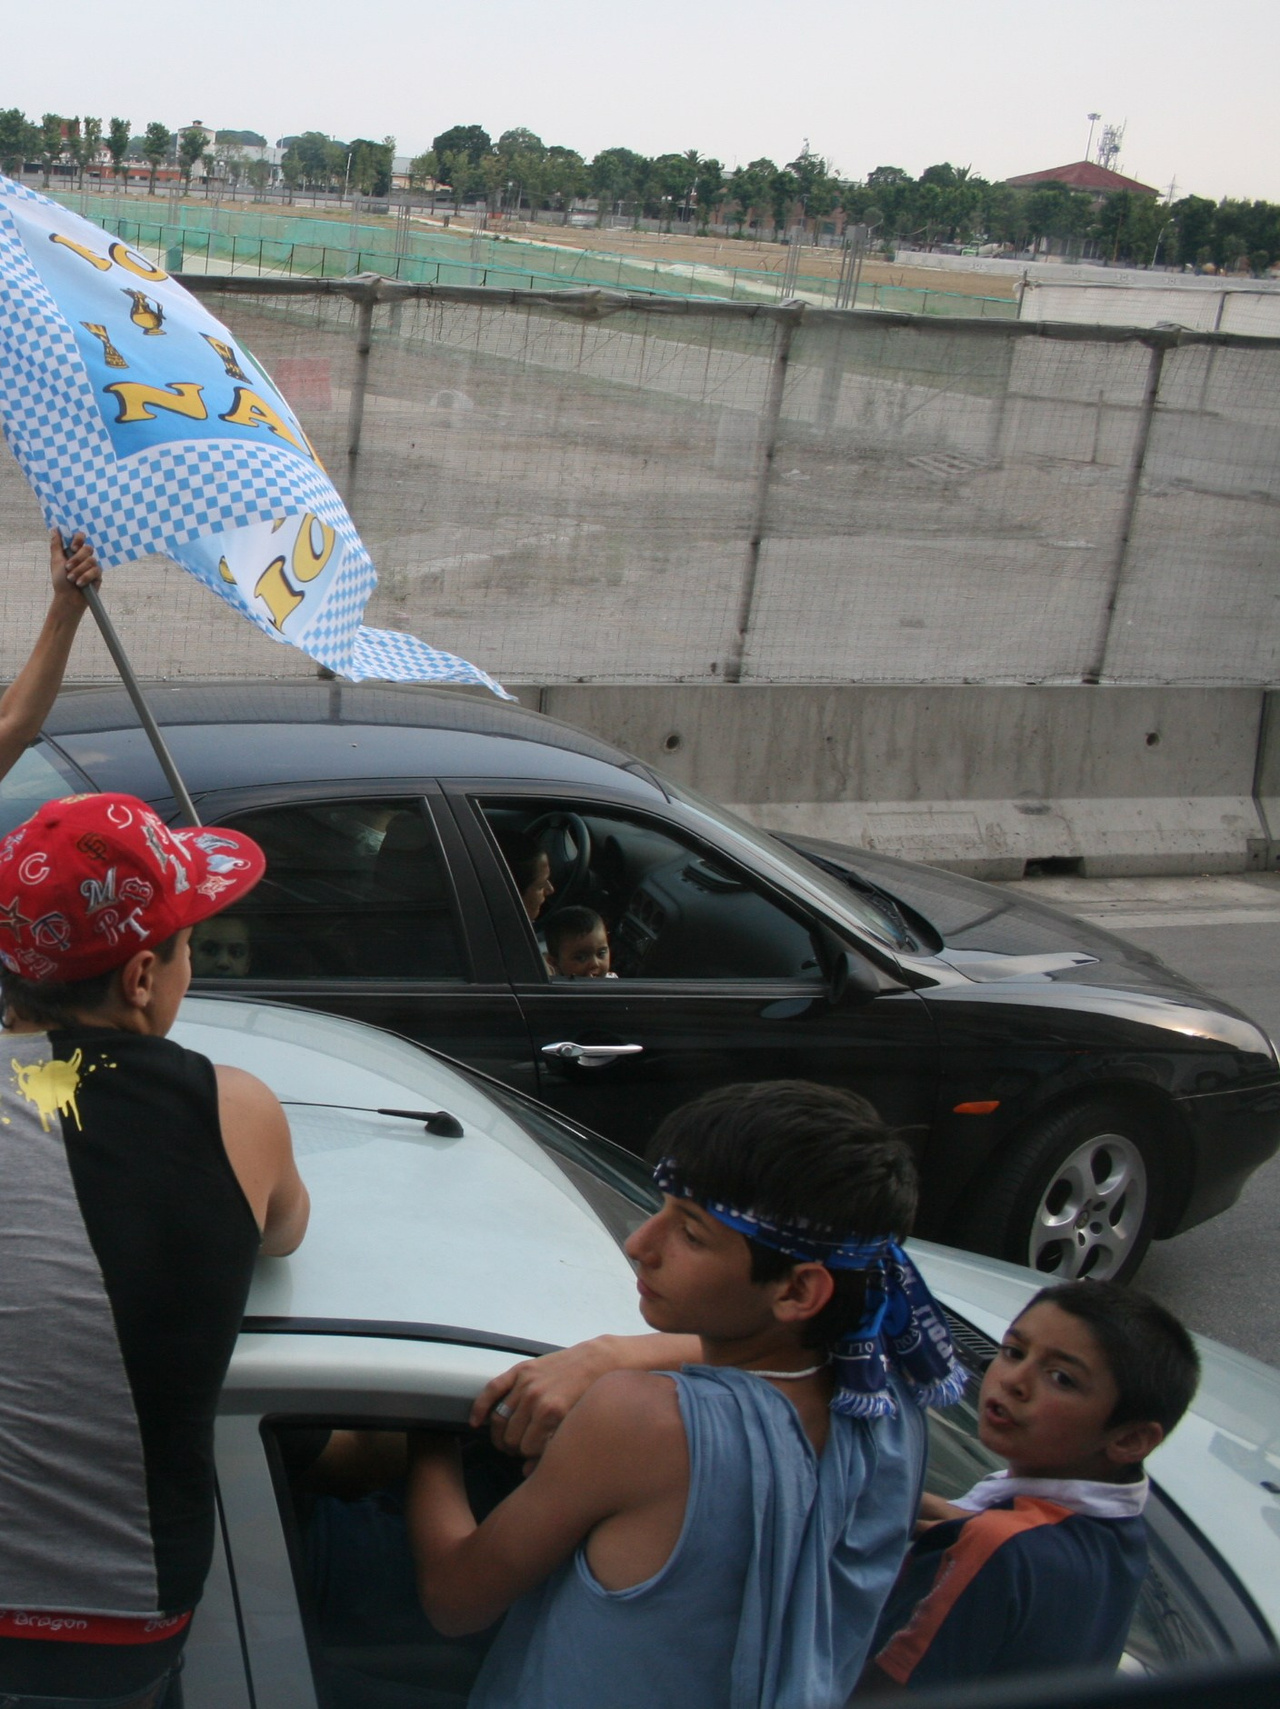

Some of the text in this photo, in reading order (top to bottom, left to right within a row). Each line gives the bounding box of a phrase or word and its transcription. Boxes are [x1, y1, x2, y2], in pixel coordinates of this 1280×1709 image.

[19, 851, 50, 886] C
[80, 866, 118, 914] M
[118, 907, 151, 942] T
